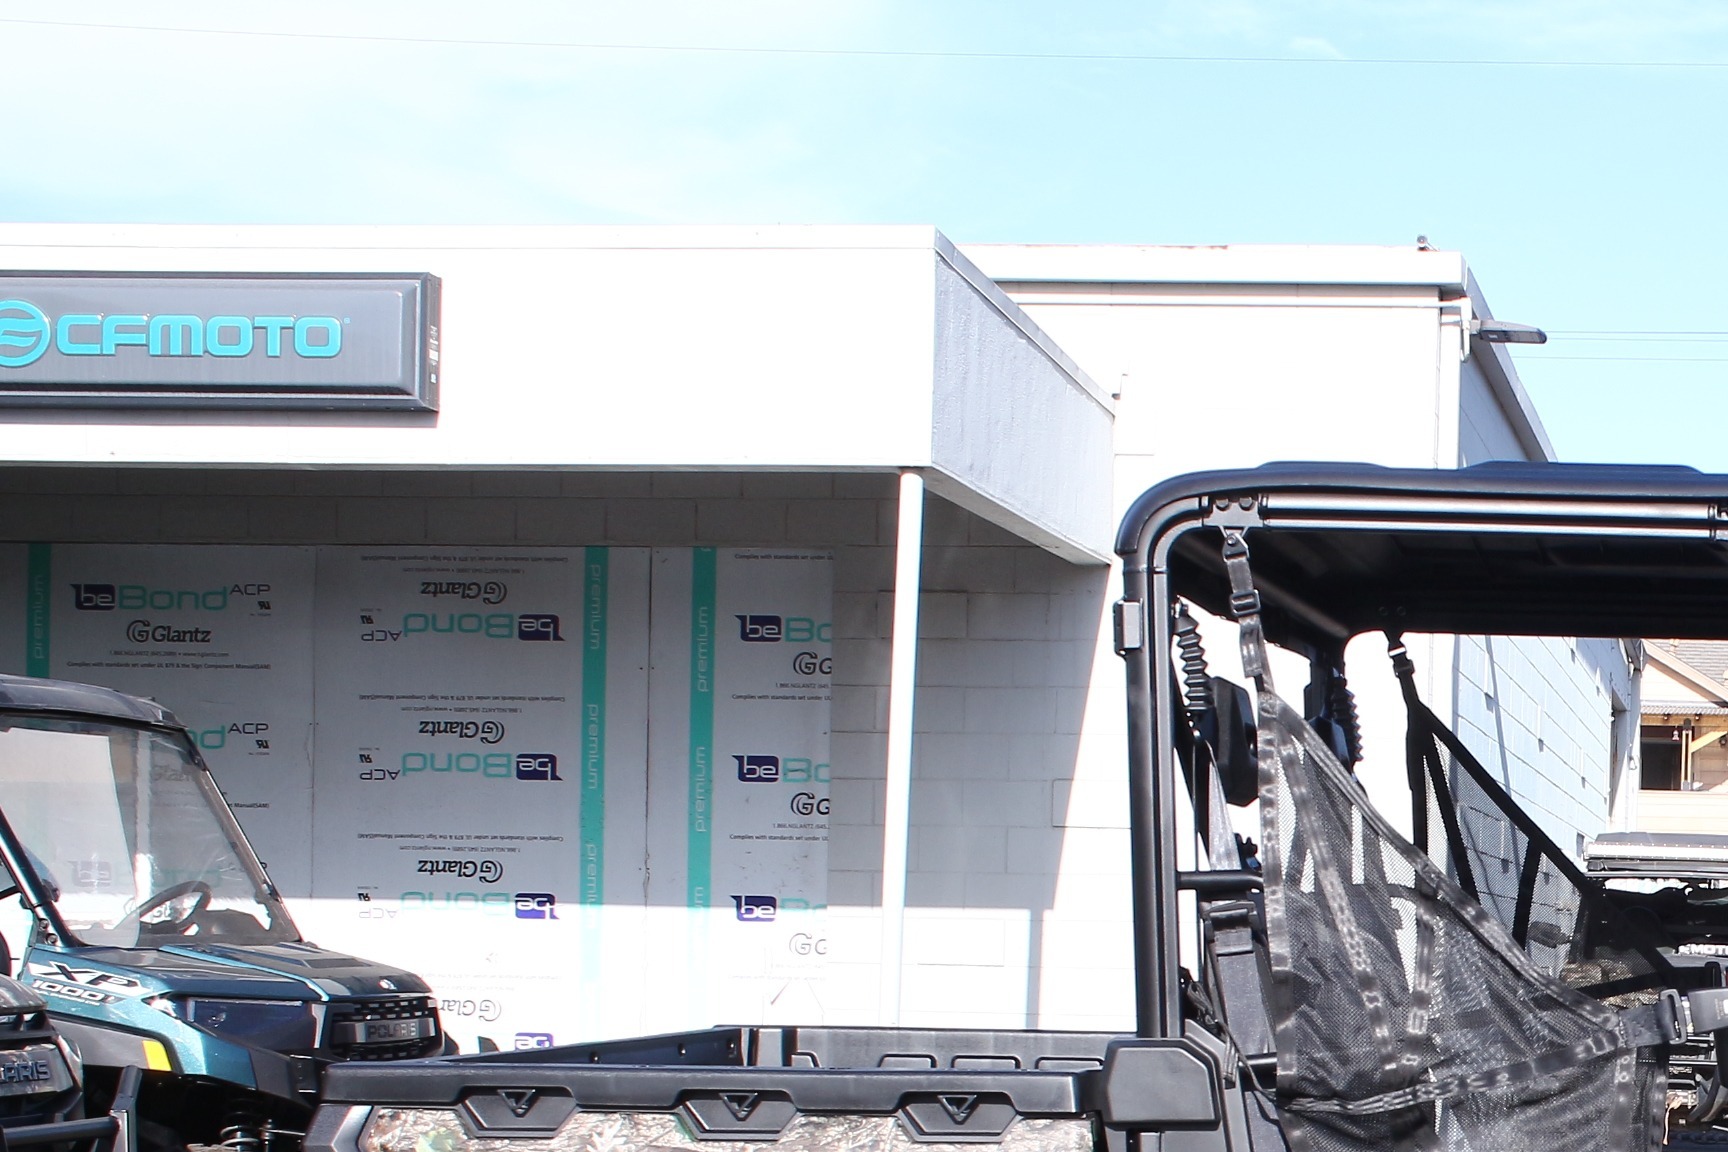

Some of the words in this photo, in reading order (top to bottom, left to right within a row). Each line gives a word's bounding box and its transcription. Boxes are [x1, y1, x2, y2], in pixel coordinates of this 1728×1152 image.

[56, 314, 342, 357] CFMOTO
[229, 584, 270, 595] ACP
[420, 582, 481, 599] Glantz
[590, 564, 601, 650] premium
[152, 626, 211, 643] Glantz
[361, 630, 402, 642] ACP
[228, 723, 269, 734] ACP
[419, 721, 479, 738] Glantz
[587, 704, 598, 789] premium
[360, 769, 400, 780] ACP
[696, 747, 706, 832] premium
[417, 860, 477, 877] Glantz
[359, 907, 397, 918] ACP
[366, 1022, 418, 1040] POLARIS
